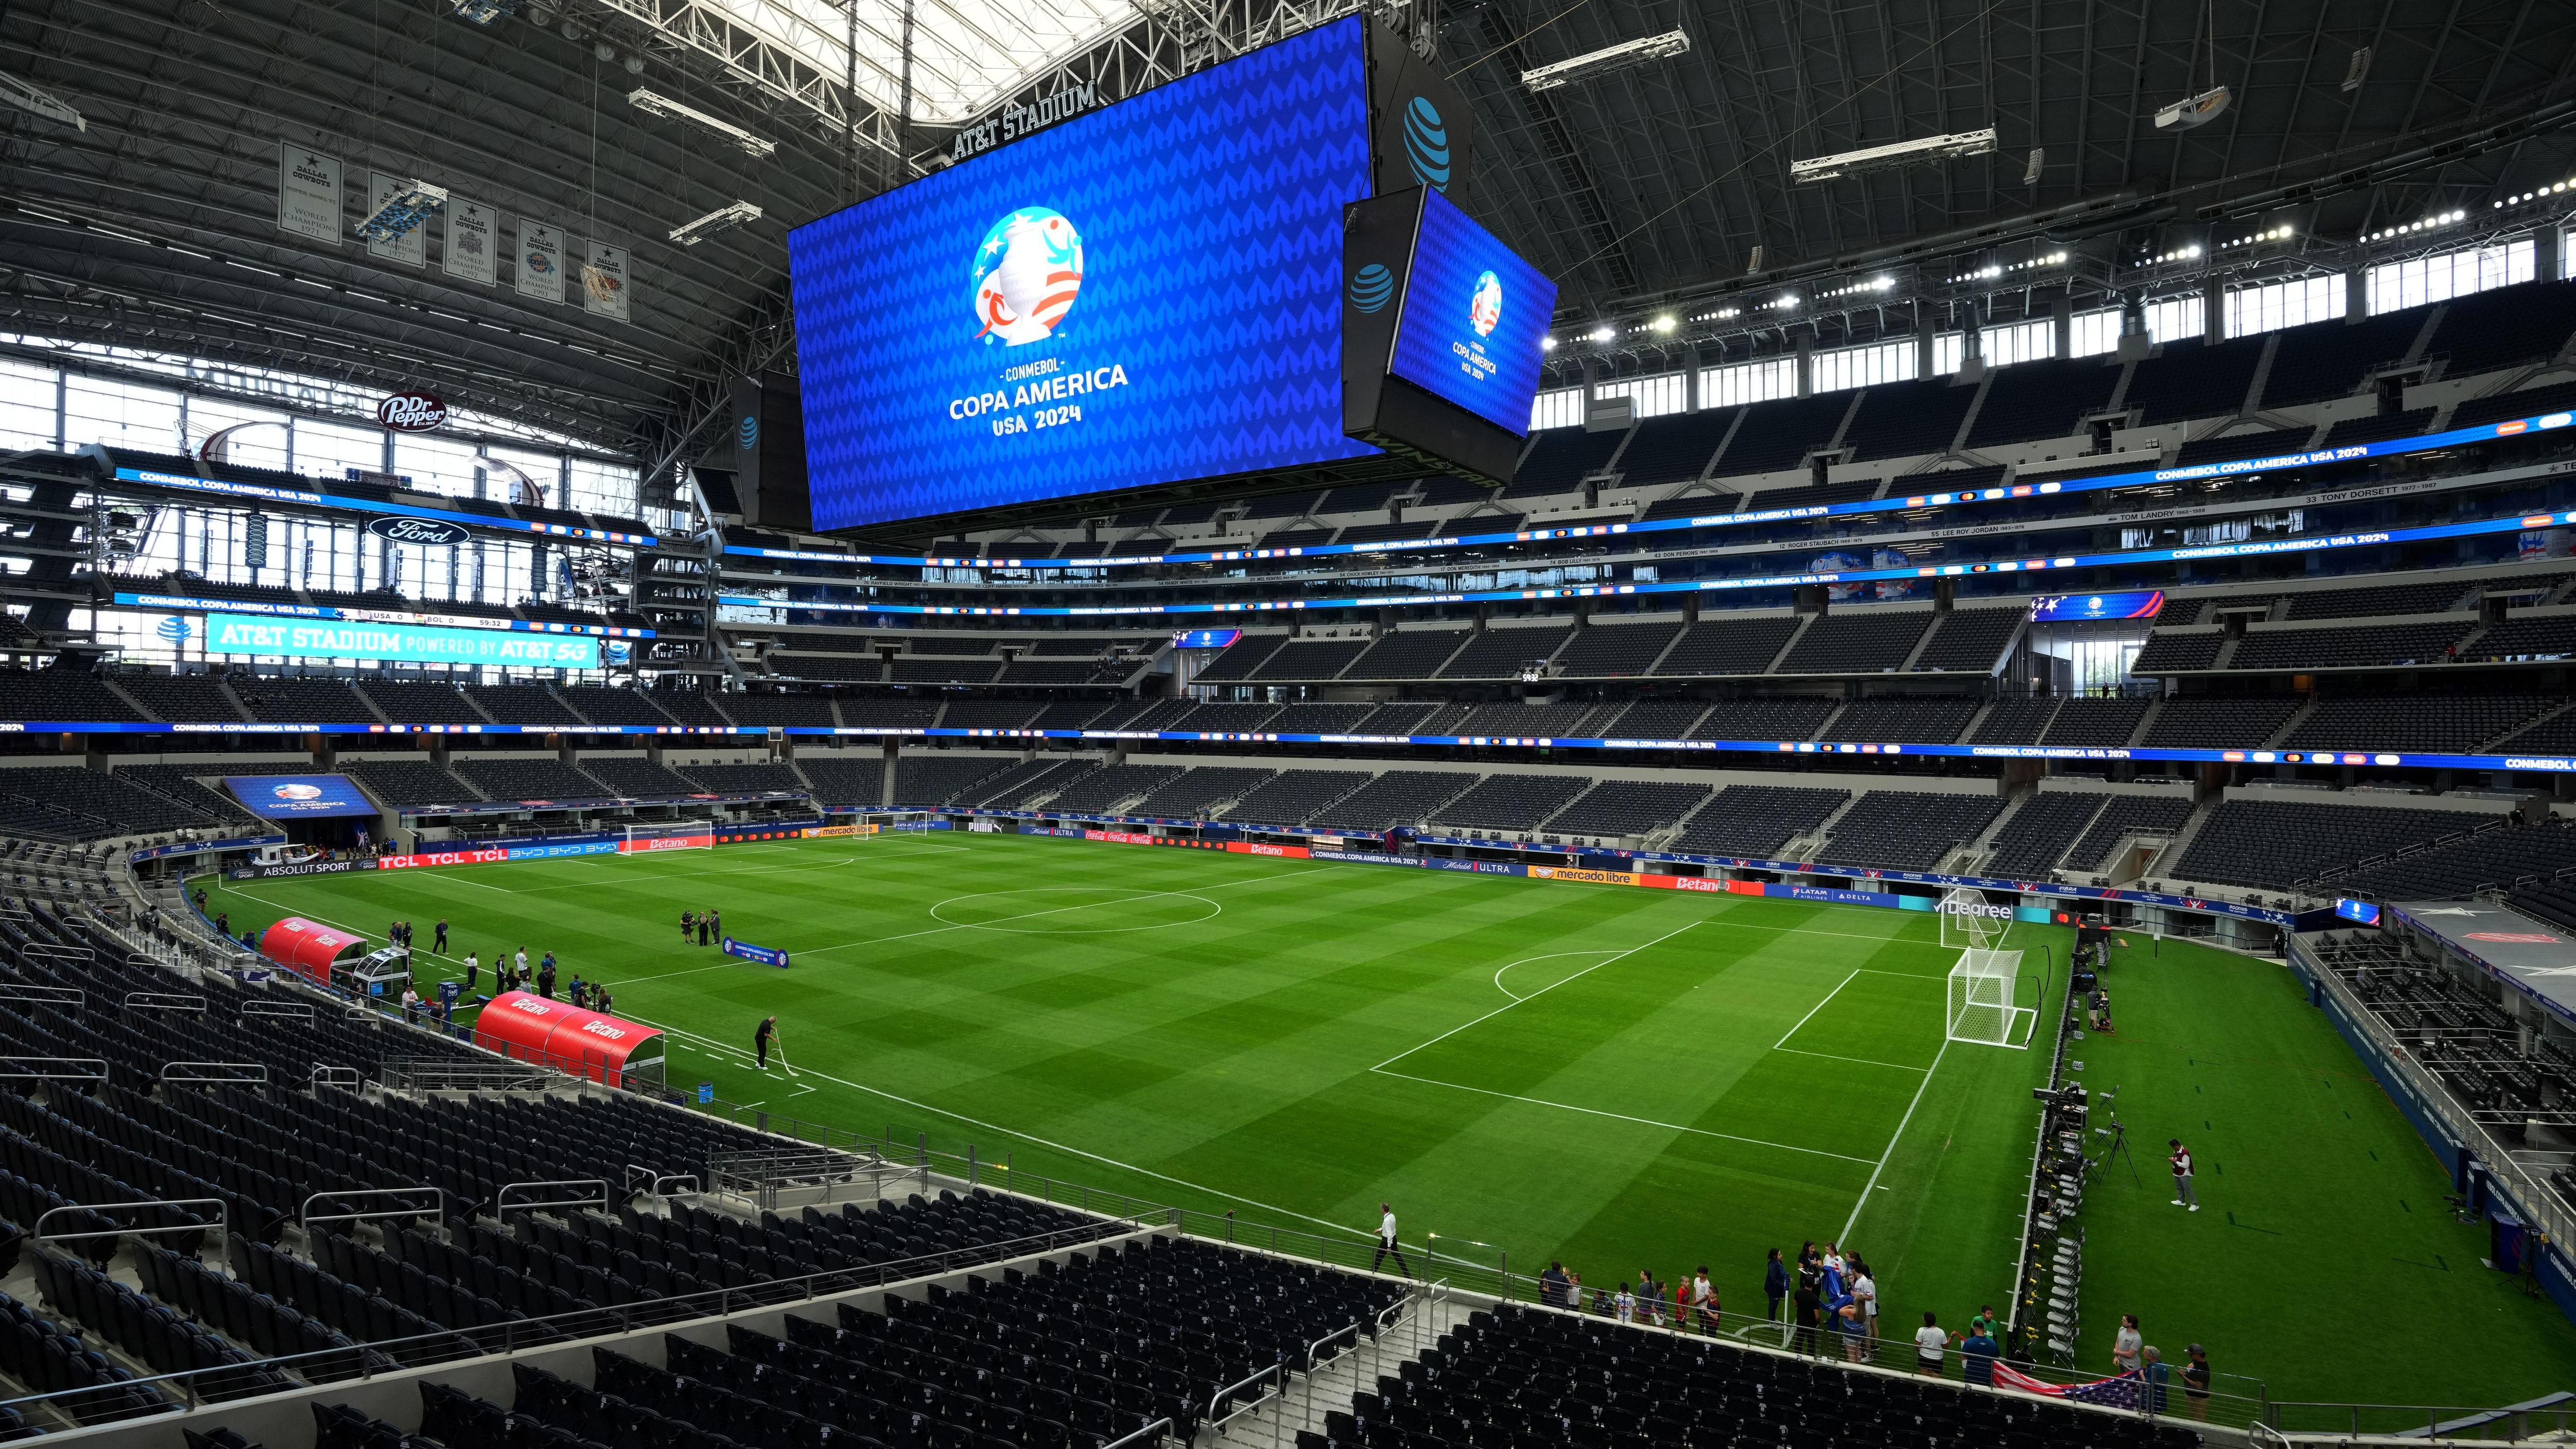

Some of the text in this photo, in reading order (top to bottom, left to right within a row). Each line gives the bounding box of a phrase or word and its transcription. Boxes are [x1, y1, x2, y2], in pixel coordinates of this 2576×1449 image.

[953, 79, 1096, 161] AT&T STADIUM
[297, 165, 327, 179] DALLAS
[293, 172, 330, 187] COWBOYS
[294, 206, 327, 221] WORLD
[459, 215, 484, 226] DALLAS
[284, 212, 337, 232] CHAMPIONS
[456, 220, 487, 234] COWBOYS
[301, 225, 319, 235] 1971
[527, 242, 556, 254] COWBOYS
[530, 236, 553, 248] DALLAS
[388, 250, 406, 259] 1977
[457, 253, 484, 266] WORLD
[448, 257, 492, 275] CHAMPIONS
[594, 263, 621, 274] COWBOYS
[597, 257, 619, 268] DALLAS
[462, 269, 478, 278] 1992
[528, 273, 553, 285] WORLD
[520, 278, 561, 294] CHAMPIONS
[533, 288, 548, 297] 1993
[1453, 341, 1469, 360] COPA
[1470, 352, 1496, 375] AMERICA
[1006, 357, 1059, 382] CONMEBOL
[1462, 361, 1484, 381] USA 2024
[949, 364, 1128, 420] COPA AMERICA
[407, 396, 432, 412] Dr
[381, 396, 444, 427] Pepper
[993, 405, 1081, 436] USA 2024
[2155, 447, 2368, 481] CONMEBOL COPA AMERICA USA 2024
[140, 472, 321, 503] CONMEBOL COPA AMERICA USA 2024
[2321, 493, 2347, 501] TONY
[2351, 486, 2398, 498] DORSETT
[2141, 511, 2174, 519] LANDRY
[389, 520, 453, 544] Ford
[2172, 533, 2389, 558] CONMEBOL COPA AMERICA USA 2024
[219, 623, 589, 661] AT&T STADIUM POWERED BY AT&T 5G
[2046, 749, 2085, 757] AMERICA
[2505, 759, 2572, 770] CONMEBOL
[823, 826, 856, 835] mercado
[968, 823, 993, 832] PUMA
[510, 844, 616, 858] BYD BYD BYD
[650, 839, 688, 849] Betano
[1251, 844, 1282, 855] Betano
[380, 850, 508, 868] TCL TCL TCL
[1315, 851, 1346, 859] CONMEBOL
[264, 862, 351, 876] ABSOLUT SPORT
[1442, 861, 1509, 872] Michelob ULTRA
[1557, 870, 1630, 883] mercado libre
[1948, 900, 2011, 919] Degree
[315, 934, 339, 947] Betano
[511, 999, 550, 1015] Betano
[582, 1020, 625, 1039] Betano
